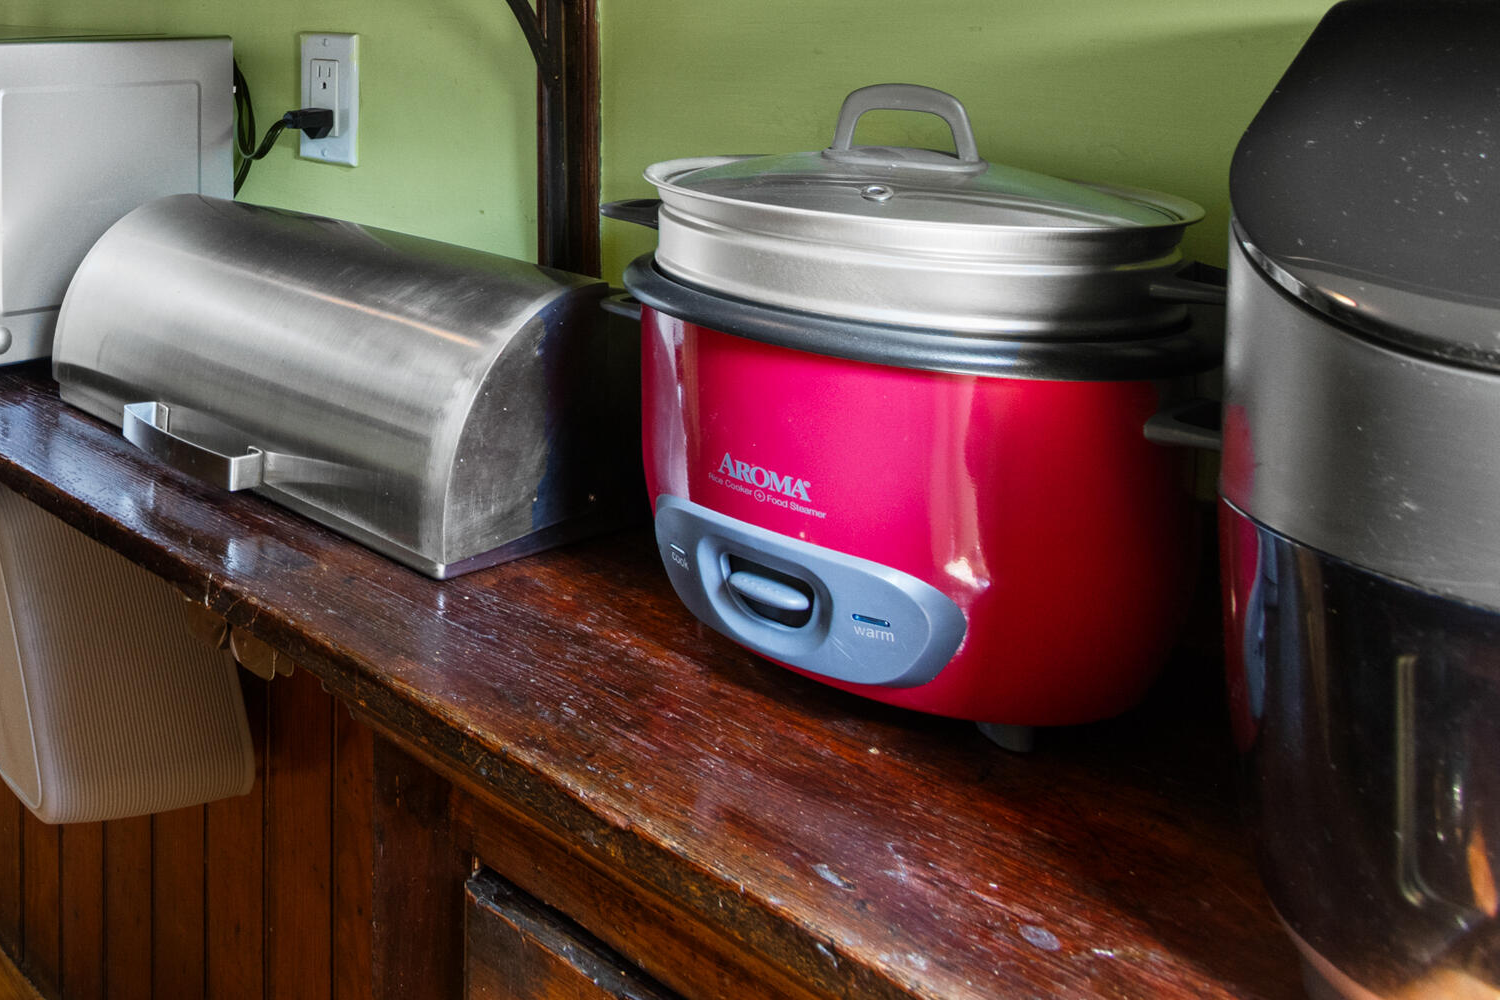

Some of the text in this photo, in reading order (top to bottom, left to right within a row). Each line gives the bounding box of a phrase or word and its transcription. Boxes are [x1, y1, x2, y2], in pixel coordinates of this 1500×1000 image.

[717, 451, 812, 502] AROMA
[708, 472, 827, 520] Rice Cooker Food Steamer
[670, 551, 690, 571] cook
[853, 624, 895, 643] warm
